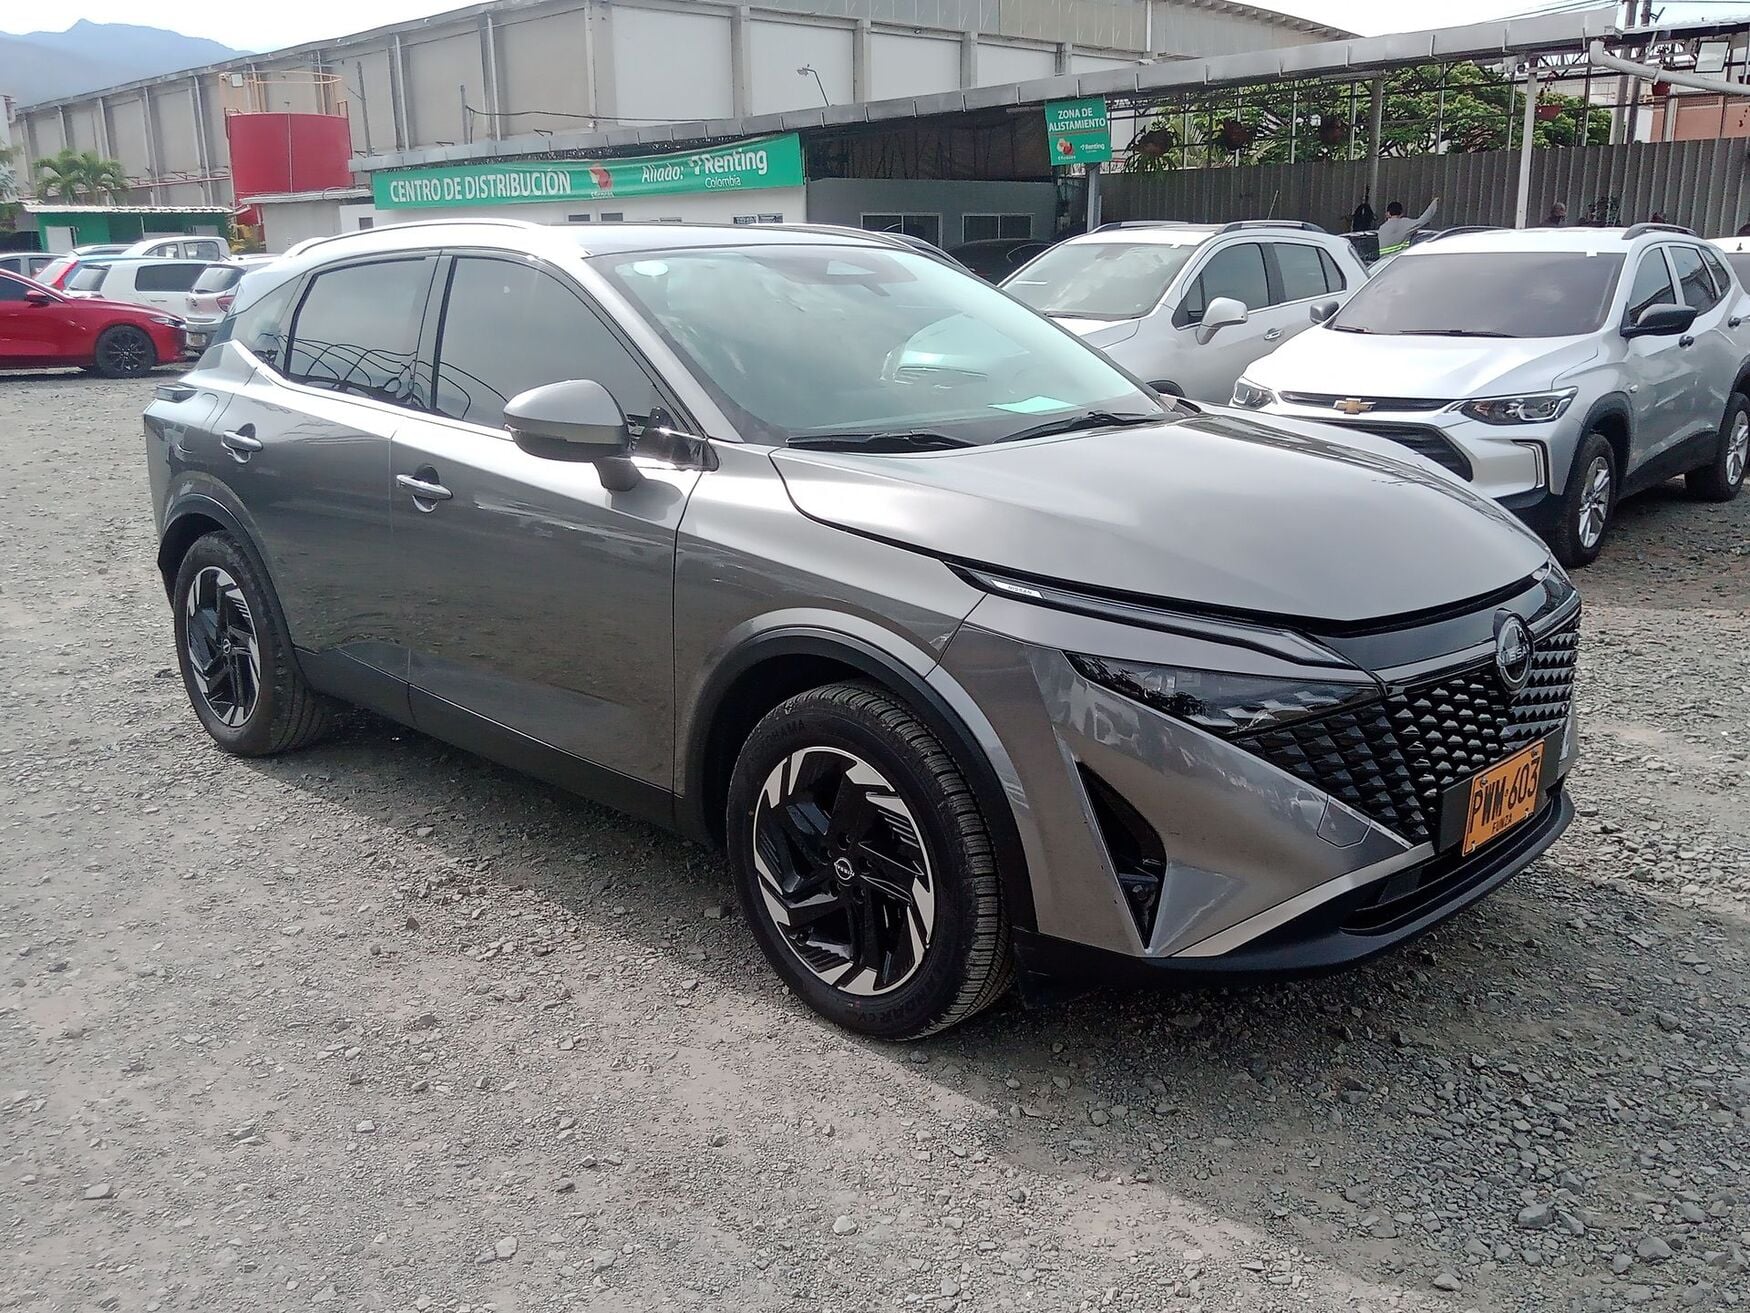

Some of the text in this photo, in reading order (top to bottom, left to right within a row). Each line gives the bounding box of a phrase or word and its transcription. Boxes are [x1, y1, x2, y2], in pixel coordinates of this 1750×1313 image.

[1057, 107, 1093, 119] ZONA DE
[1048, 118, 1106, 132] ALISTAMIENTO
[704, 148, 768, 176] Renting
[641, 162, 684, 184] Aliado:
[704, 174, 742, 189] Colombia
[390, 168, 572, 203] CENTRO DE DISTRIBUCIÓN
